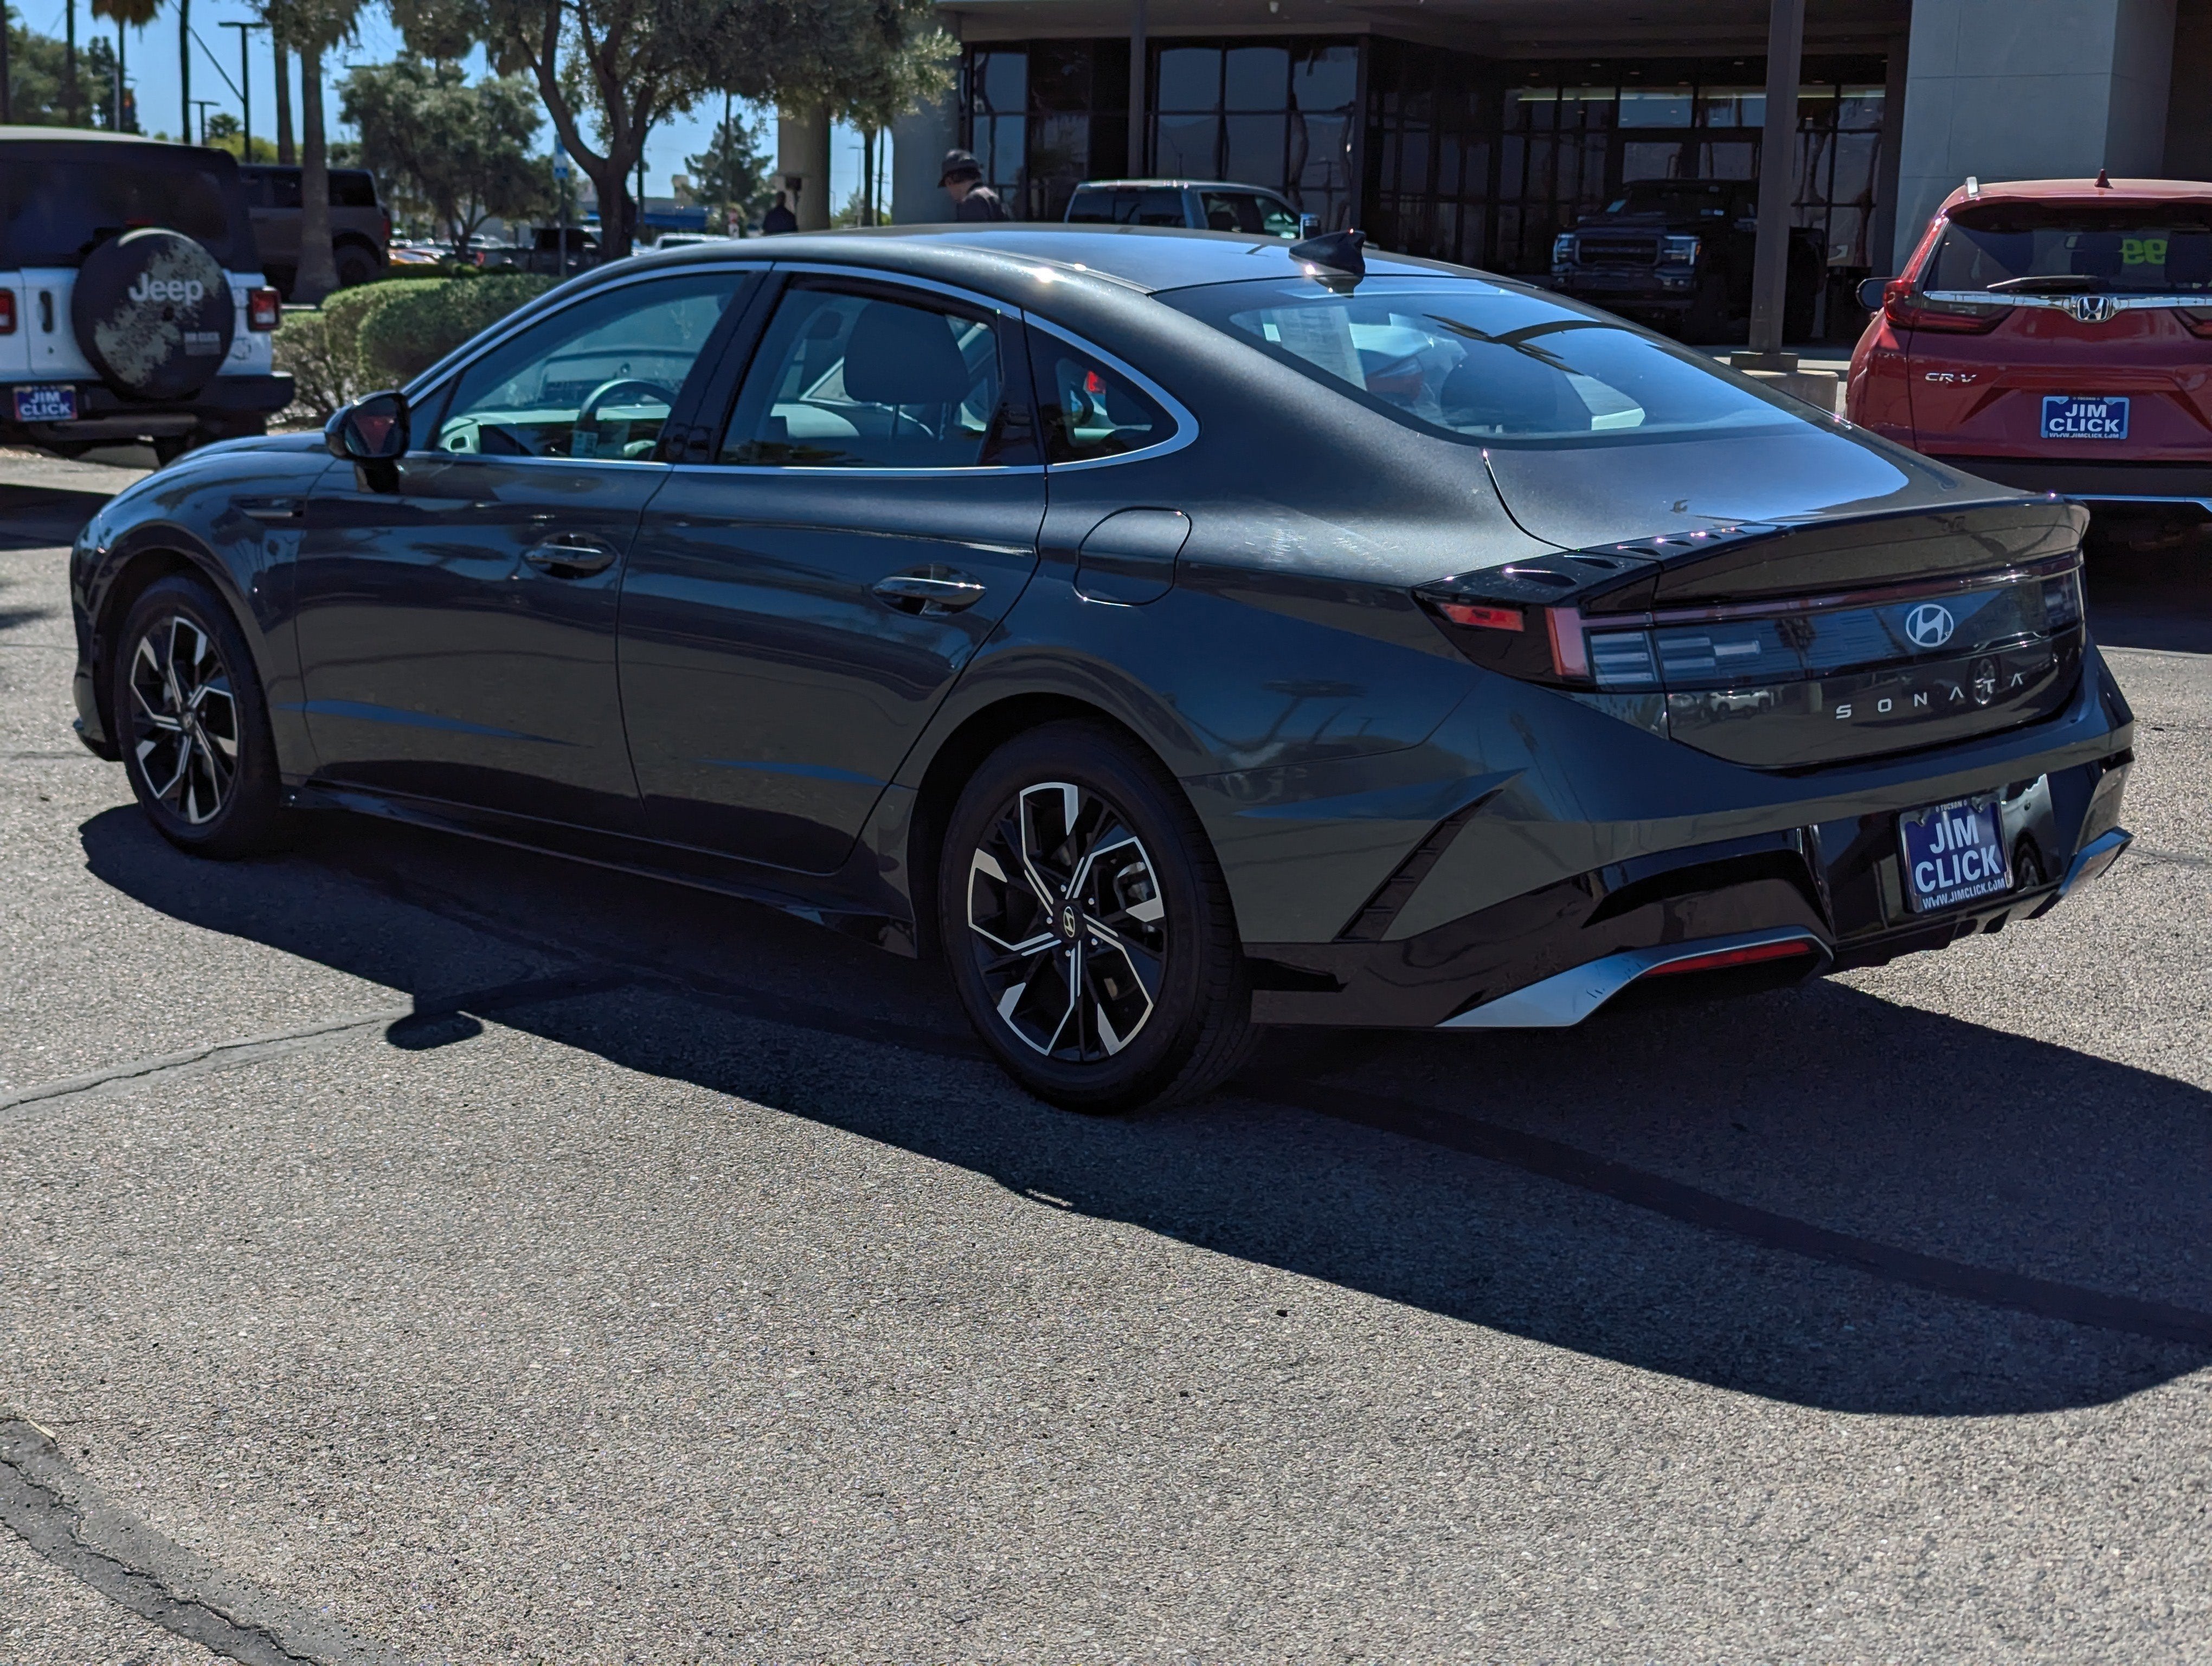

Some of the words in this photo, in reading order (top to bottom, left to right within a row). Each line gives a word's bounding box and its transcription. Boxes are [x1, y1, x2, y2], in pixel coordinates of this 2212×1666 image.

[128, 272, 204, 306] Jeep
[1925, 373, 1977, 383] CR-V
[30, 390, 61, 403] JIM
[21, 403, 71, 415] CLICK
[2065, 403, 2107, 418] JIM
[2049, 418, 2120, 432] CLICK
[1836, 672, 2024, 720] SONATA
[1929, 814, 1979, 854] JIM
[1915, 844, 2001, 893] CLICK
